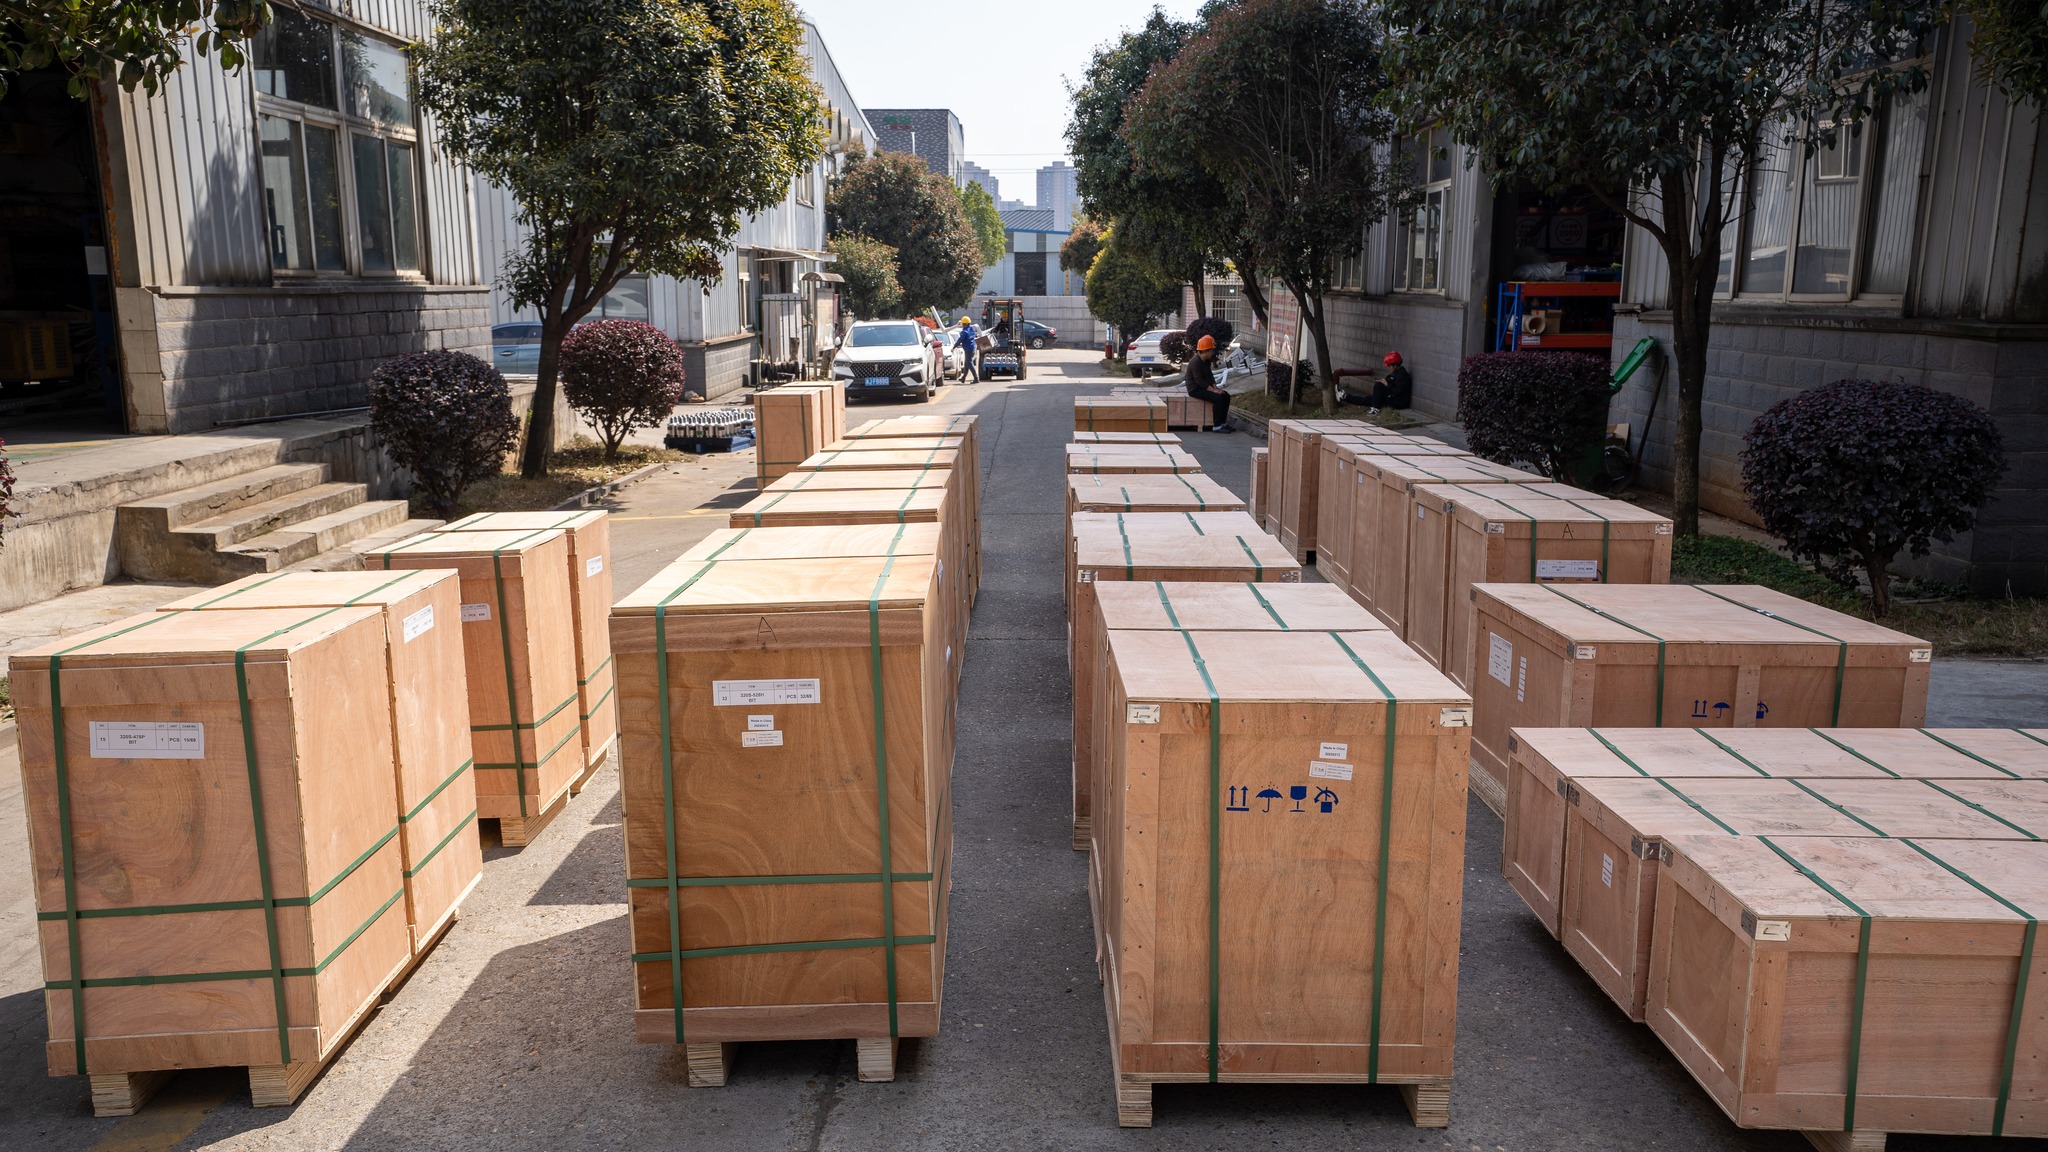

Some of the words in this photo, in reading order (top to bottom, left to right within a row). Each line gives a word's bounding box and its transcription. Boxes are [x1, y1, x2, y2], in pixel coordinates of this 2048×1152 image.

[1562, 523, 1574, 540] A
[757, 616, 778, 645] A
[1708, 885, 1716, 915] A
